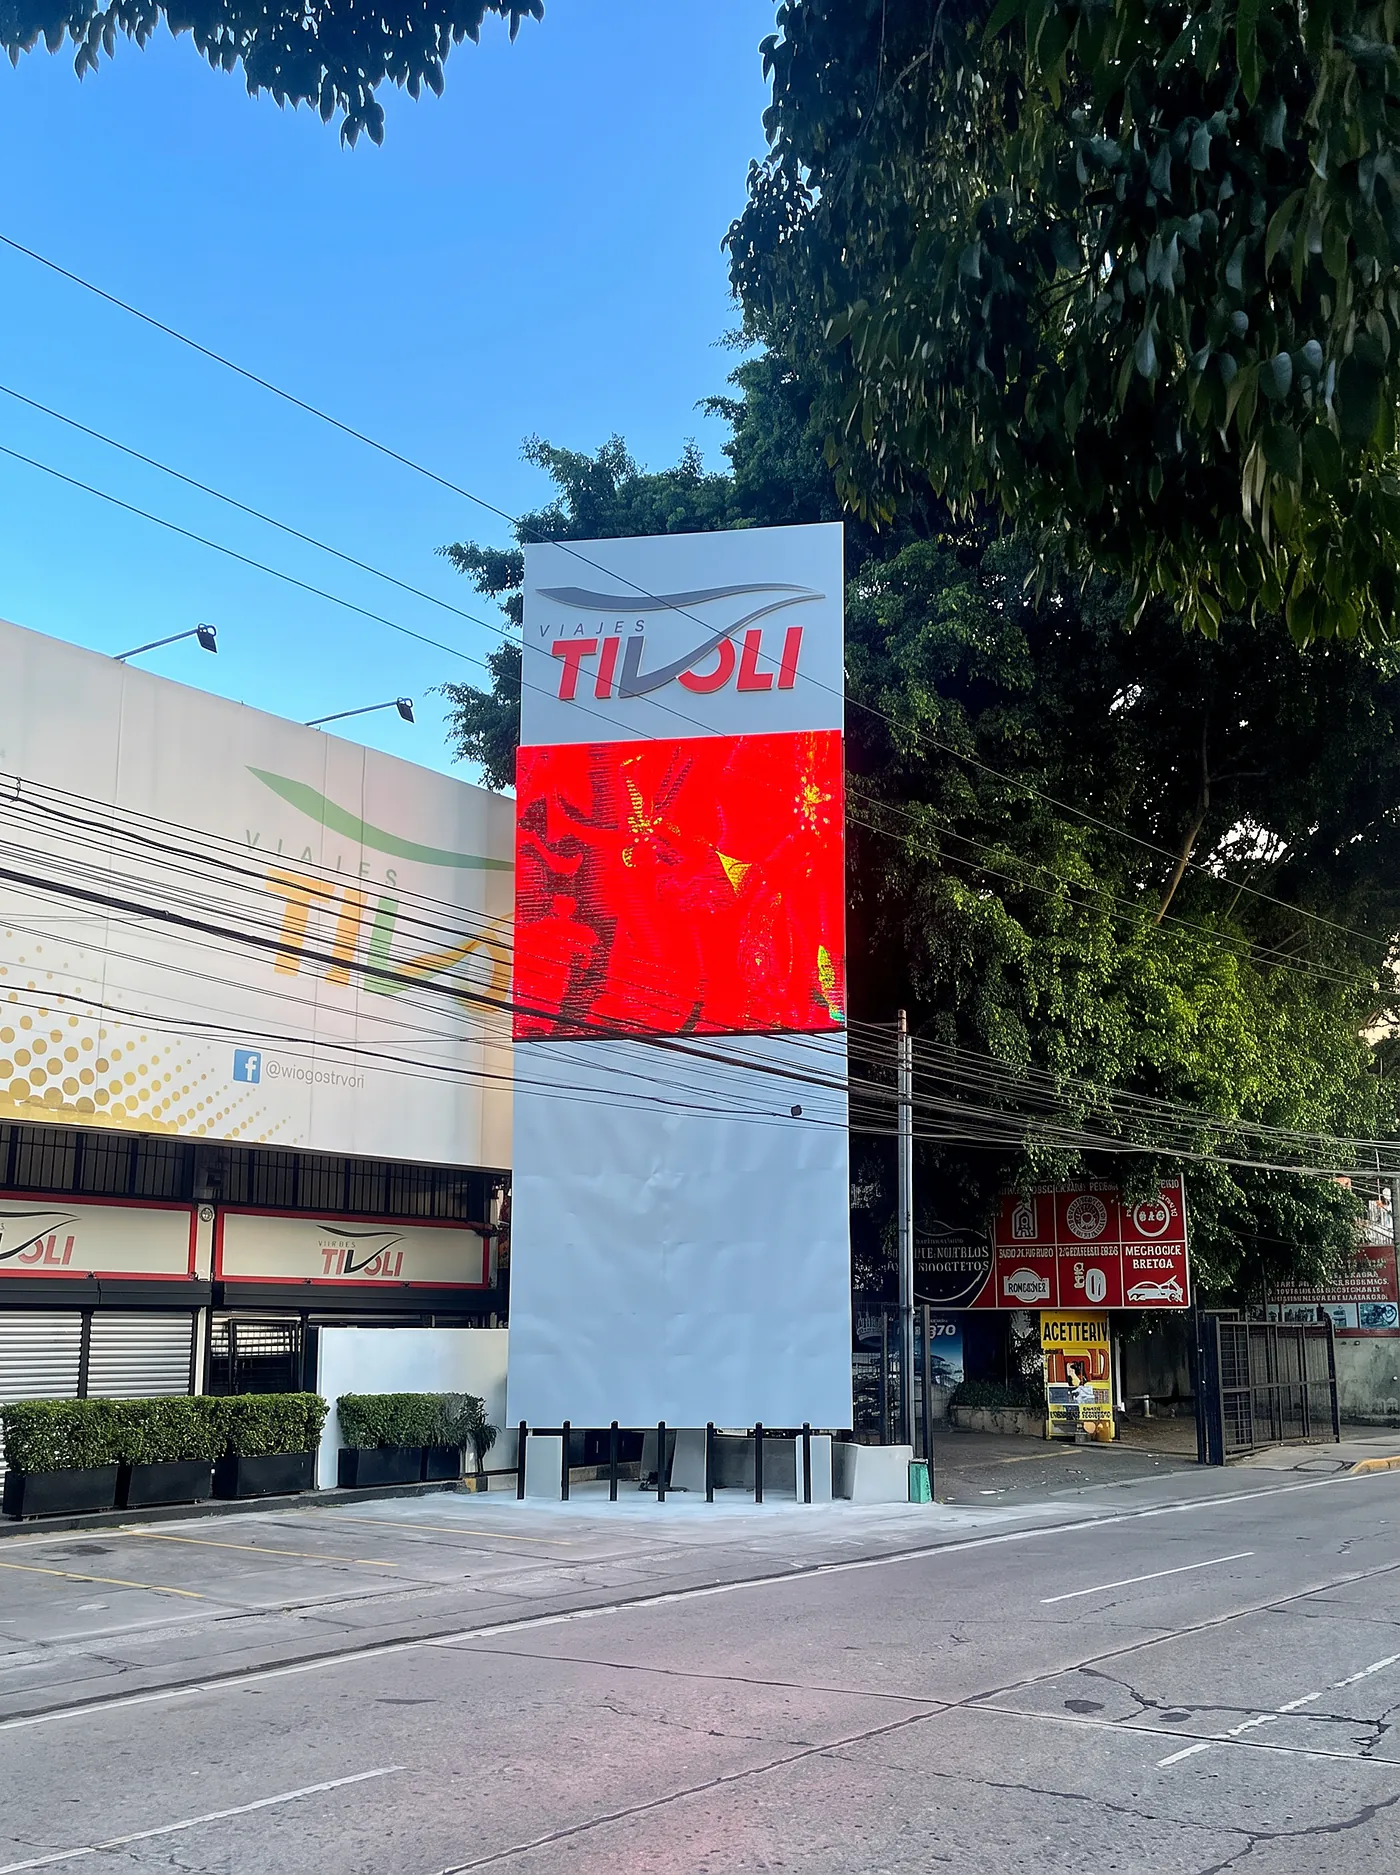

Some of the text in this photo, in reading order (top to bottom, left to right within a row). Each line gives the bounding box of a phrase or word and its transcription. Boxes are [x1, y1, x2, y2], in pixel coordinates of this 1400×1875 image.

[539, 619, 646, 638] VIAJES
[551, 622, 806, 701] TIVOLI
[321, 1247, 404, 1277] TIVOLI
